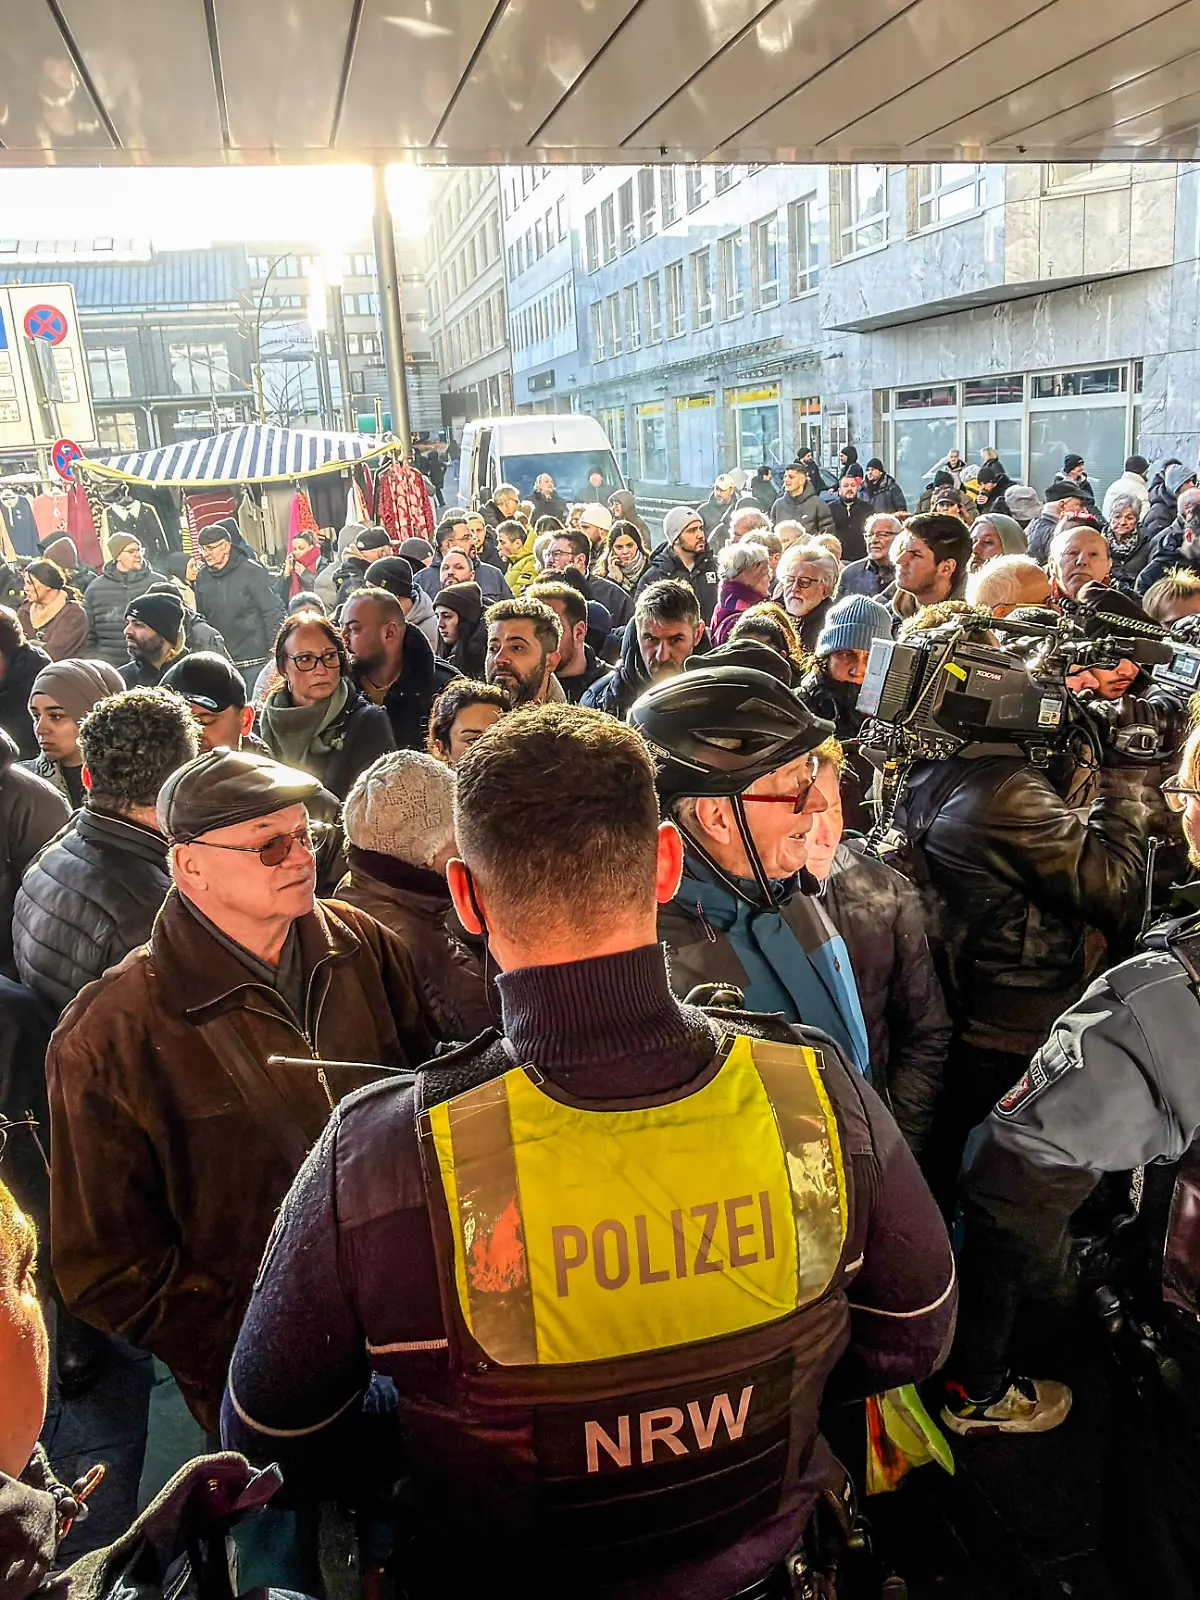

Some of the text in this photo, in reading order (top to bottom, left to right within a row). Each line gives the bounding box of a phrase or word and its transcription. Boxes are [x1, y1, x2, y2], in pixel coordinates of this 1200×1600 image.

[975, 669, 1002, 681] XDCAM
[551, 1190, 776, 1298] POLIZEI
[583, 1384, 754, 1473] NRW
